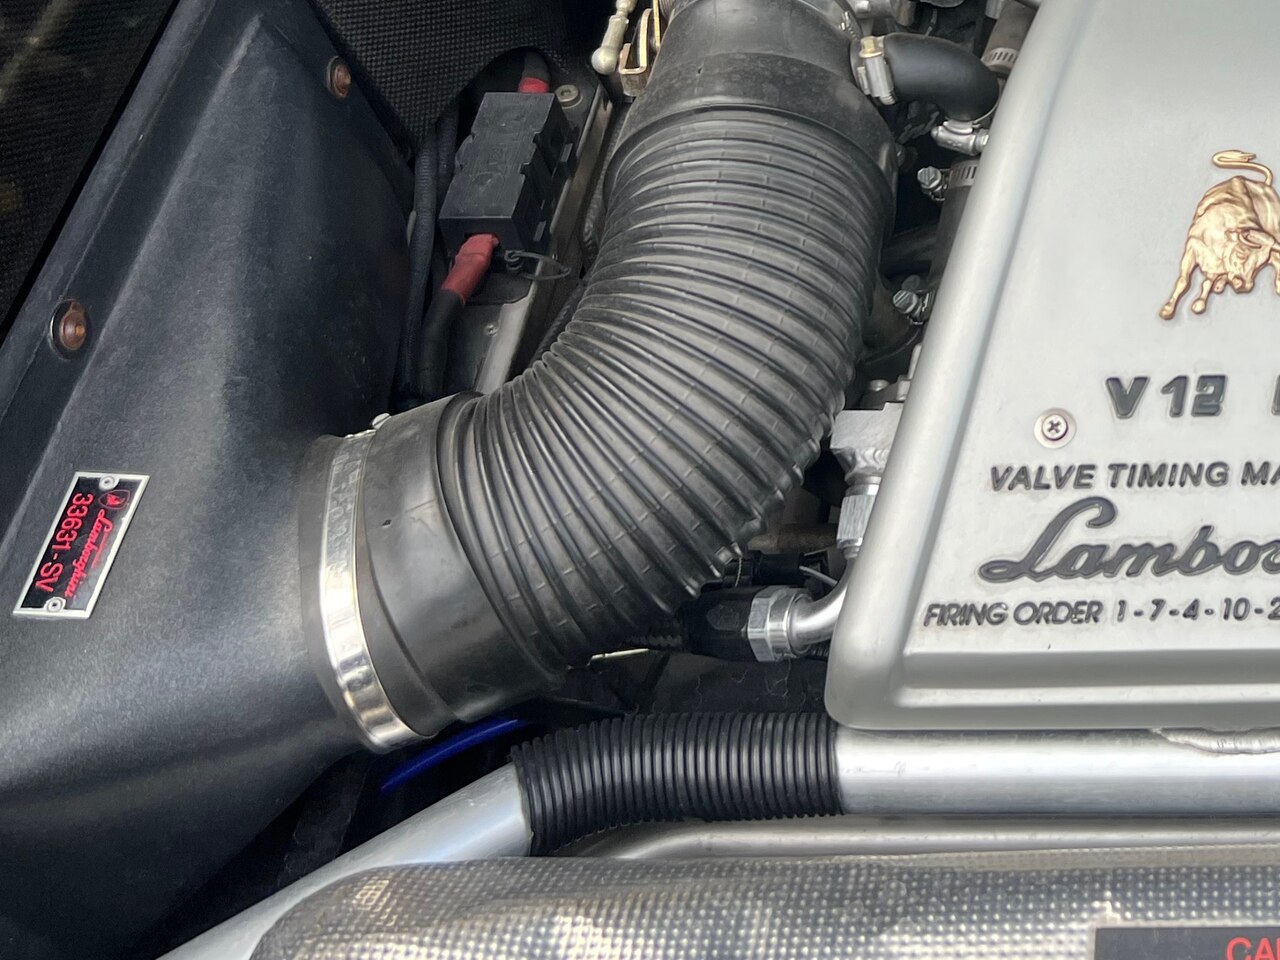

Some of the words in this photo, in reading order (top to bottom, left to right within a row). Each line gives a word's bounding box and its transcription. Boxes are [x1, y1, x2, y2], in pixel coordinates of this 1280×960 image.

[1105, 375, 1228, 419] V12
[990, 463, 1097, 490] VALVE
[1108, 461, 1230, 488] TIMING
[34, 492, 94, 592] 33631-SV
[923, 602, 1008, 627] FIRING
[1013, 600, 1104, 625] ORDER
